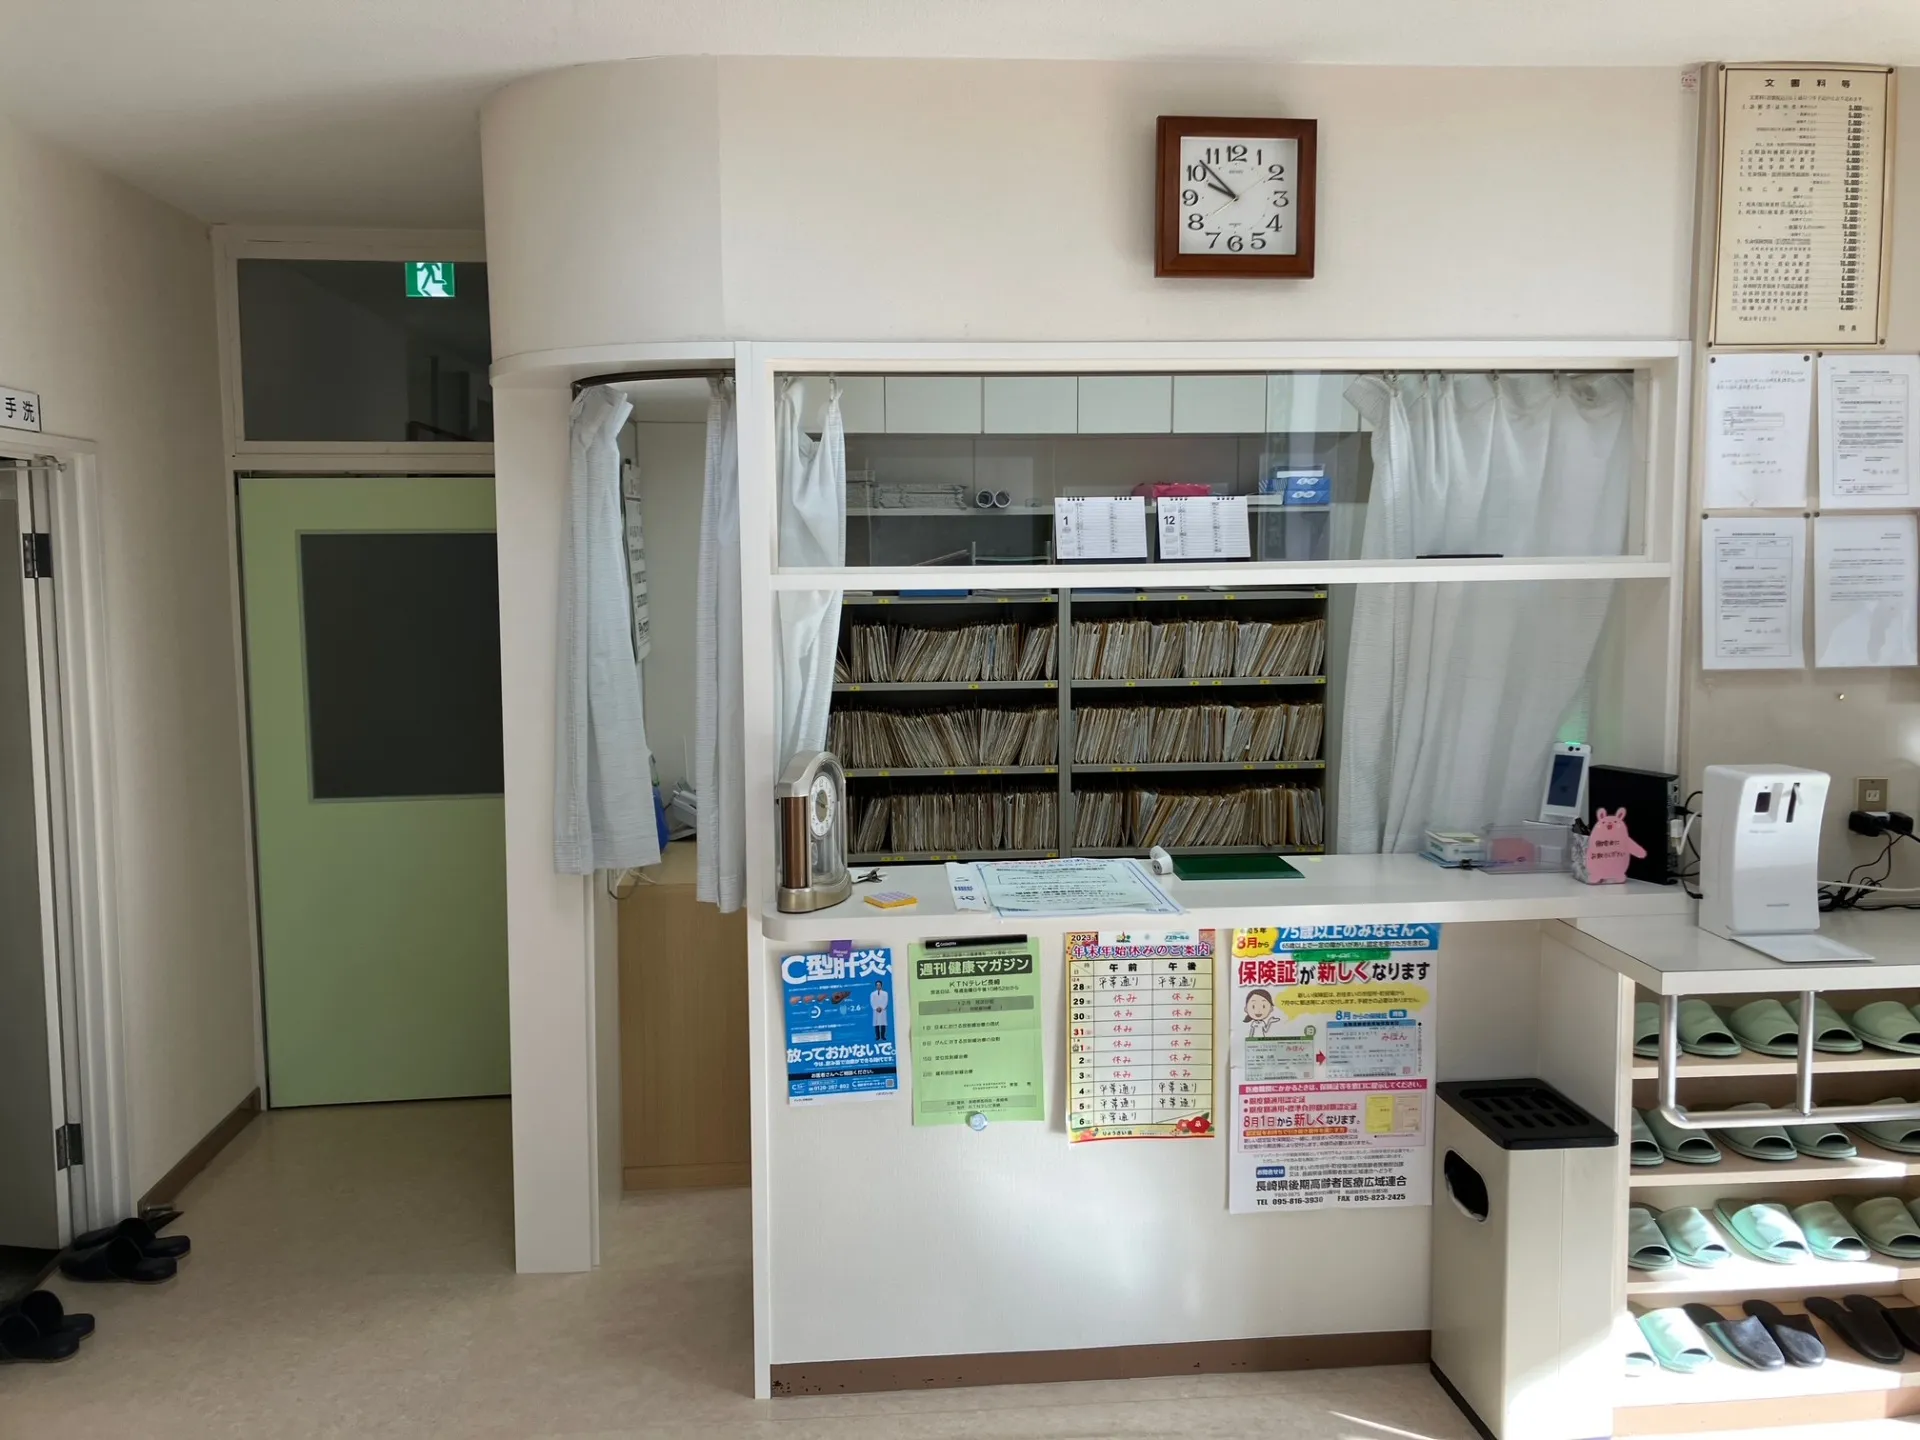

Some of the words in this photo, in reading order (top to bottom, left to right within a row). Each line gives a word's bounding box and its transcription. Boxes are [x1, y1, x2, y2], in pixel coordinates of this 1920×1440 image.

[1206, 148, 1220, 164] 11
[1226, 145, 1248, 162] 12
[1257, 149, 1262, 166] 1
[1187, 164, 1207, 182] 10
[1268, 164, 1284, 181] 2
[1182, 190, 1199, 206] 9
[1272, 190, 1290, 208] 3
[1188, 214, 1204, 230] 8
[1266, 214, 1282, 232] 4
[1205, 232, 1222, 249] 7
[1226, 235, 1244, 252] 6
[1250, 232, 1266, 250] 5
[5, 397, 34, 422] 手洗
[1064, 516, 1068, 525] 1
[1164, 516, 1175, 525] 12
[1236, 936, 1269, 949] 8月から
[787, 1042, 896, 1063] 放っておかないで。
[1256, 1176, 1407, 1192] 長崎県後期高齢者医療広域連合
